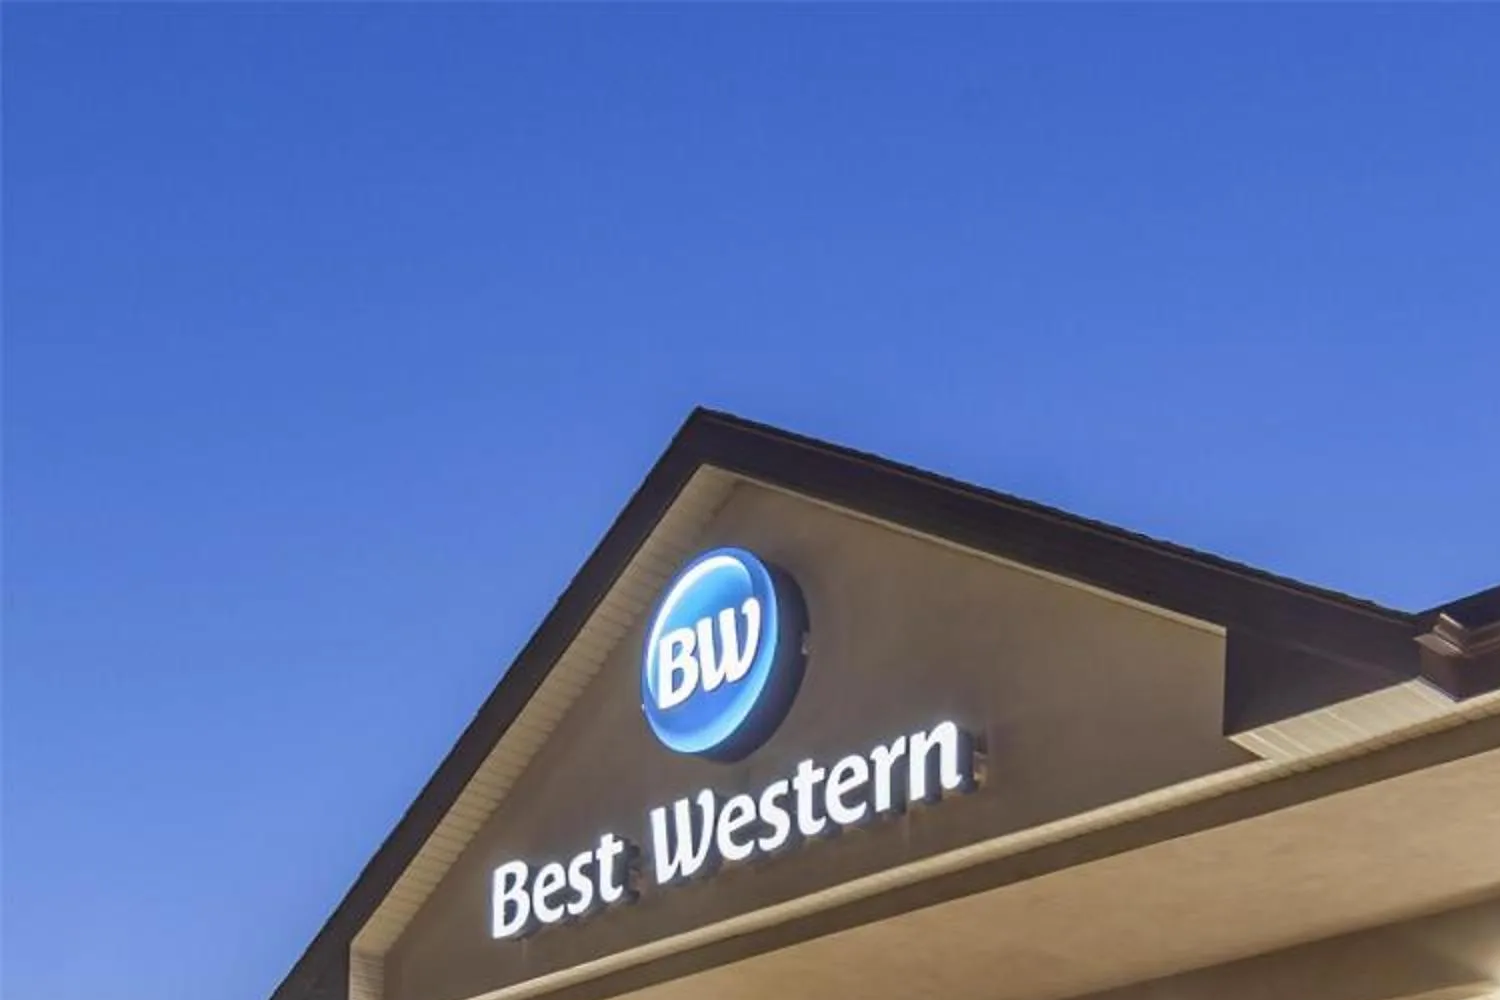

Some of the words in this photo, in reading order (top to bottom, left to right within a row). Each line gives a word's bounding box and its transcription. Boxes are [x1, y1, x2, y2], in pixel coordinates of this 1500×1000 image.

[657, 596, 761, 710] BW
[491, 832, 624, 940] Best
[649, 719, 963, 885] Western
